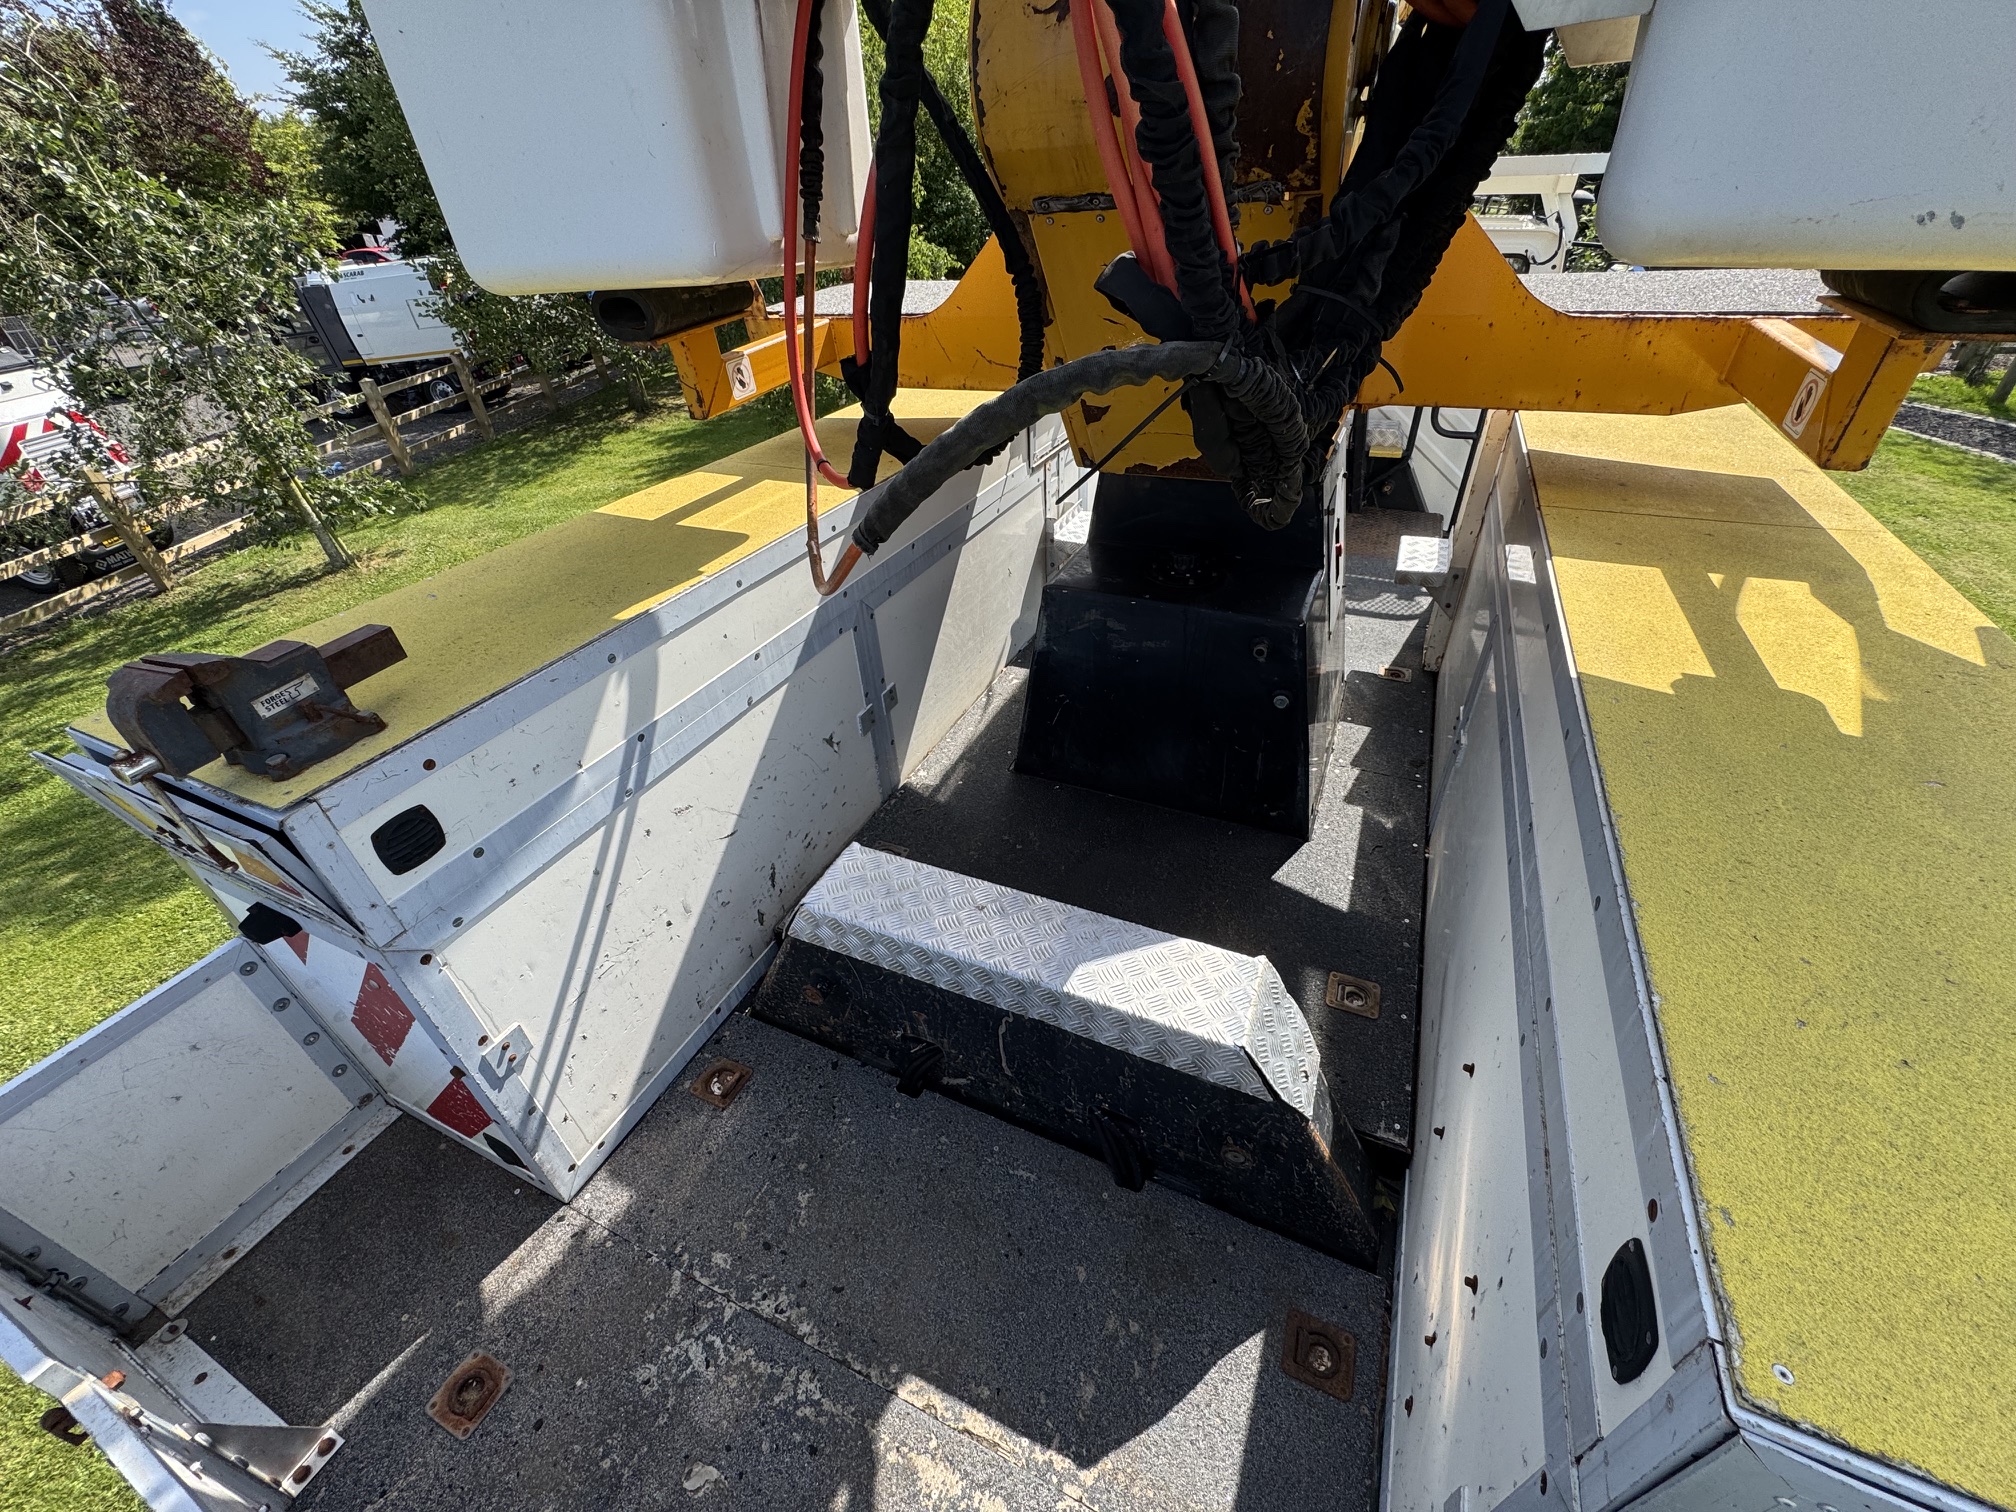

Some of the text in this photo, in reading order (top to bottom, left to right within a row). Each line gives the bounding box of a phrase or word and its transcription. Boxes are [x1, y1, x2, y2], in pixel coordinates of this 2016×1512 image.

[343, 270, 364, 278] SCARAB
[105, 549, 132, 564] MATH
[260, 691, 286, 707] FORGE
[265, 698, 290, 712] STEEL
